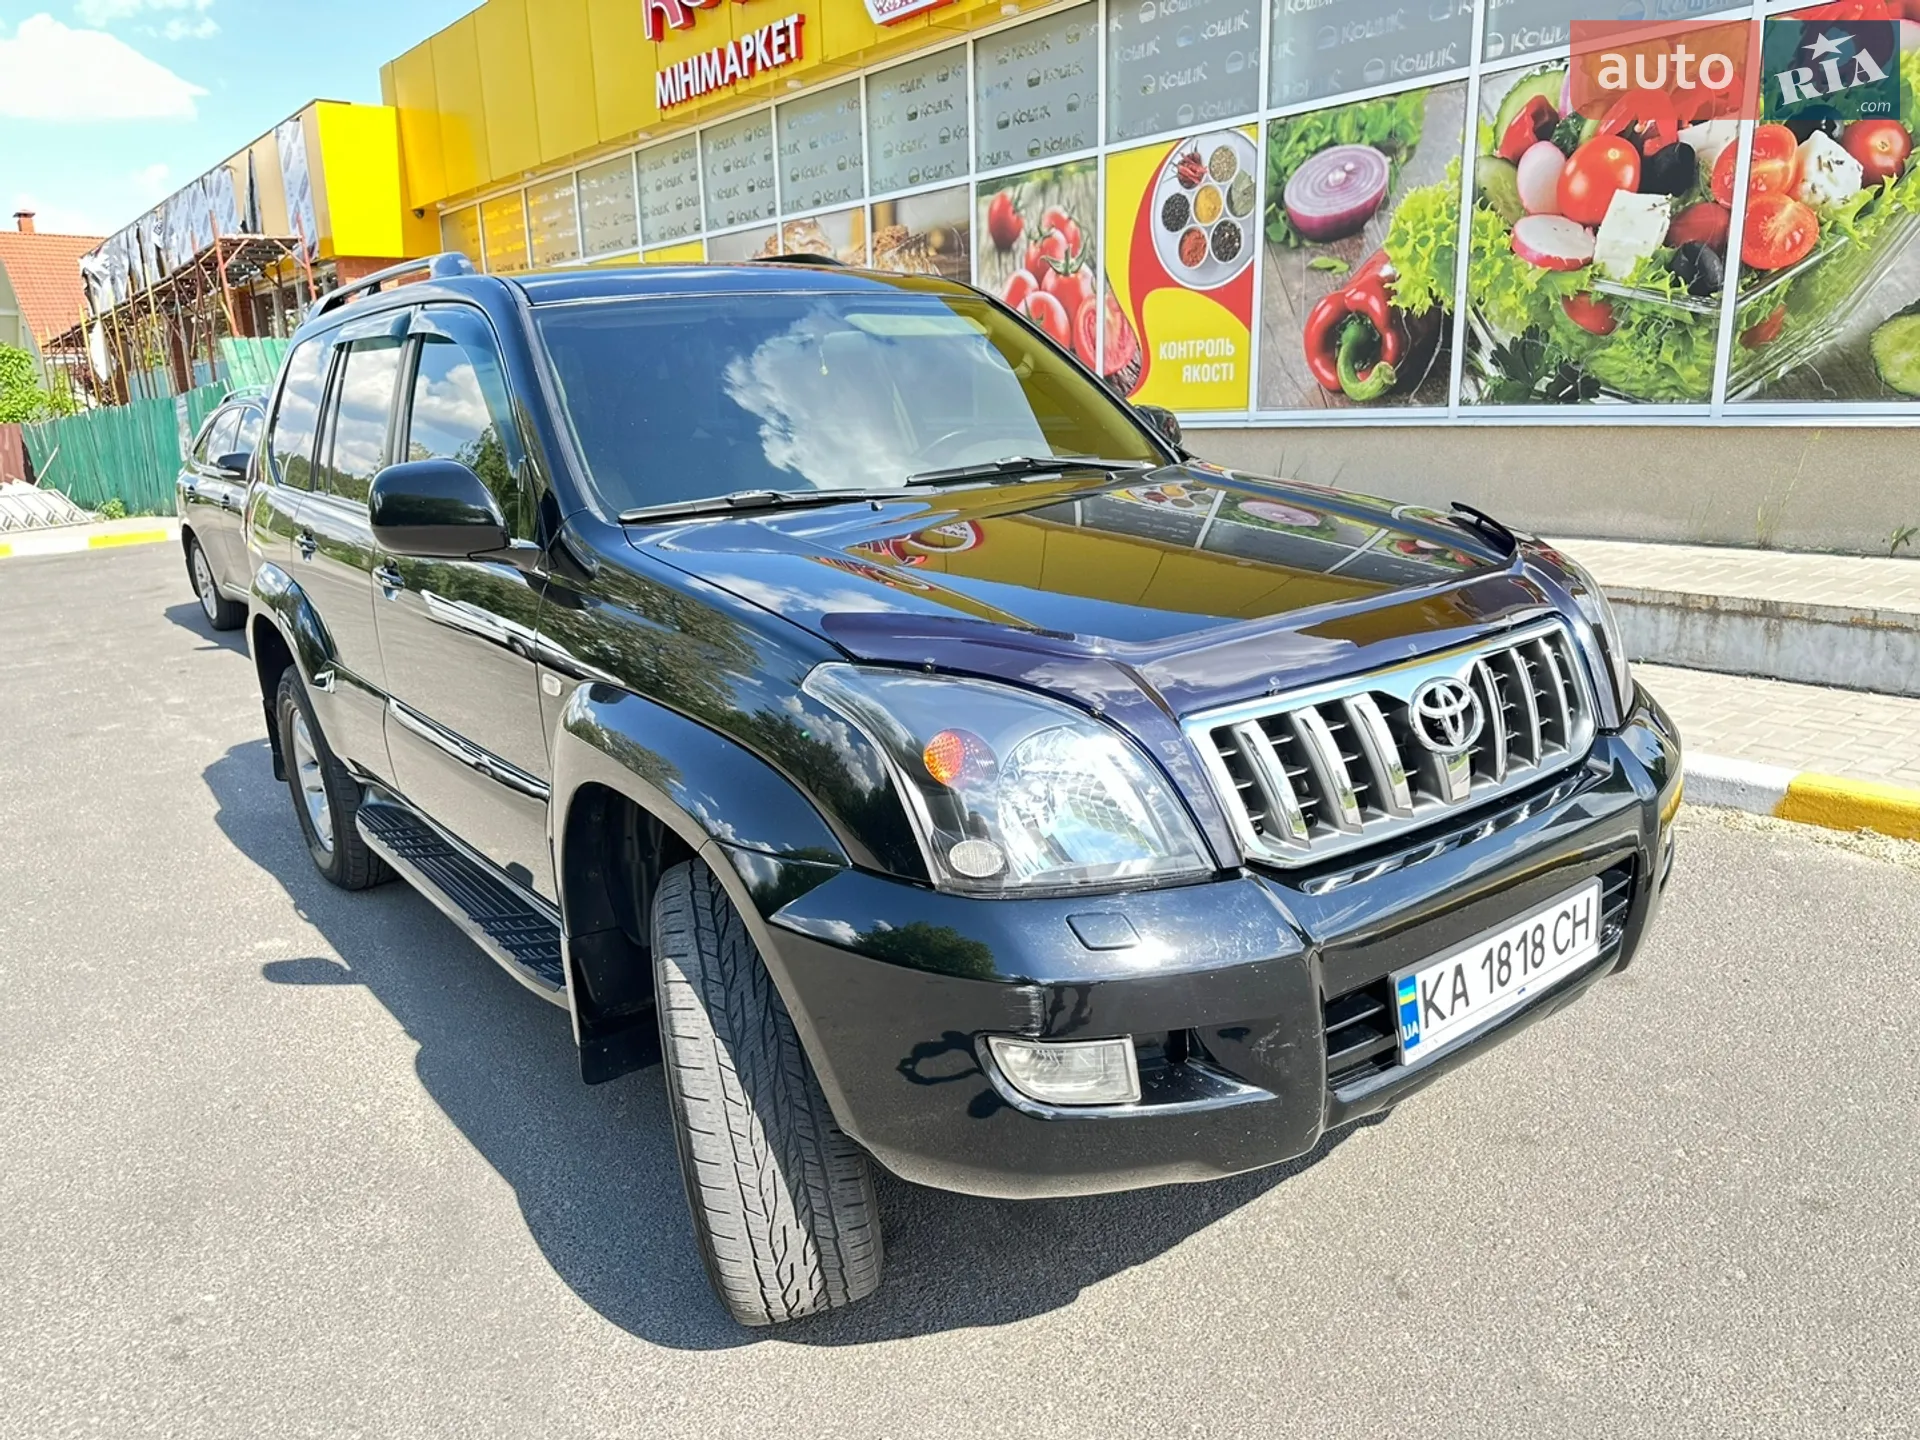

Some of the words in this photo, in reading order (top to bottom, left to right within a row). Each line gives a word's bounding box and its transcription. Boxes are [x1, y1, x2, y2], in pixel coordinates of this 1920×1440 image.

[656, 13, 803, 110] МІНІМАРКЕТ
[1159, 337, 1235, 360] КОНТРОЛЬ
[1182, 363, 1235, 383] ЯКОСТІ
[1421, 963, 1470, 1029] KA
[1481, 923, 1546, 994] 1818
[1553, 897, 1591, 955] CH
[1402, 1020, 1419, 1041] UA
